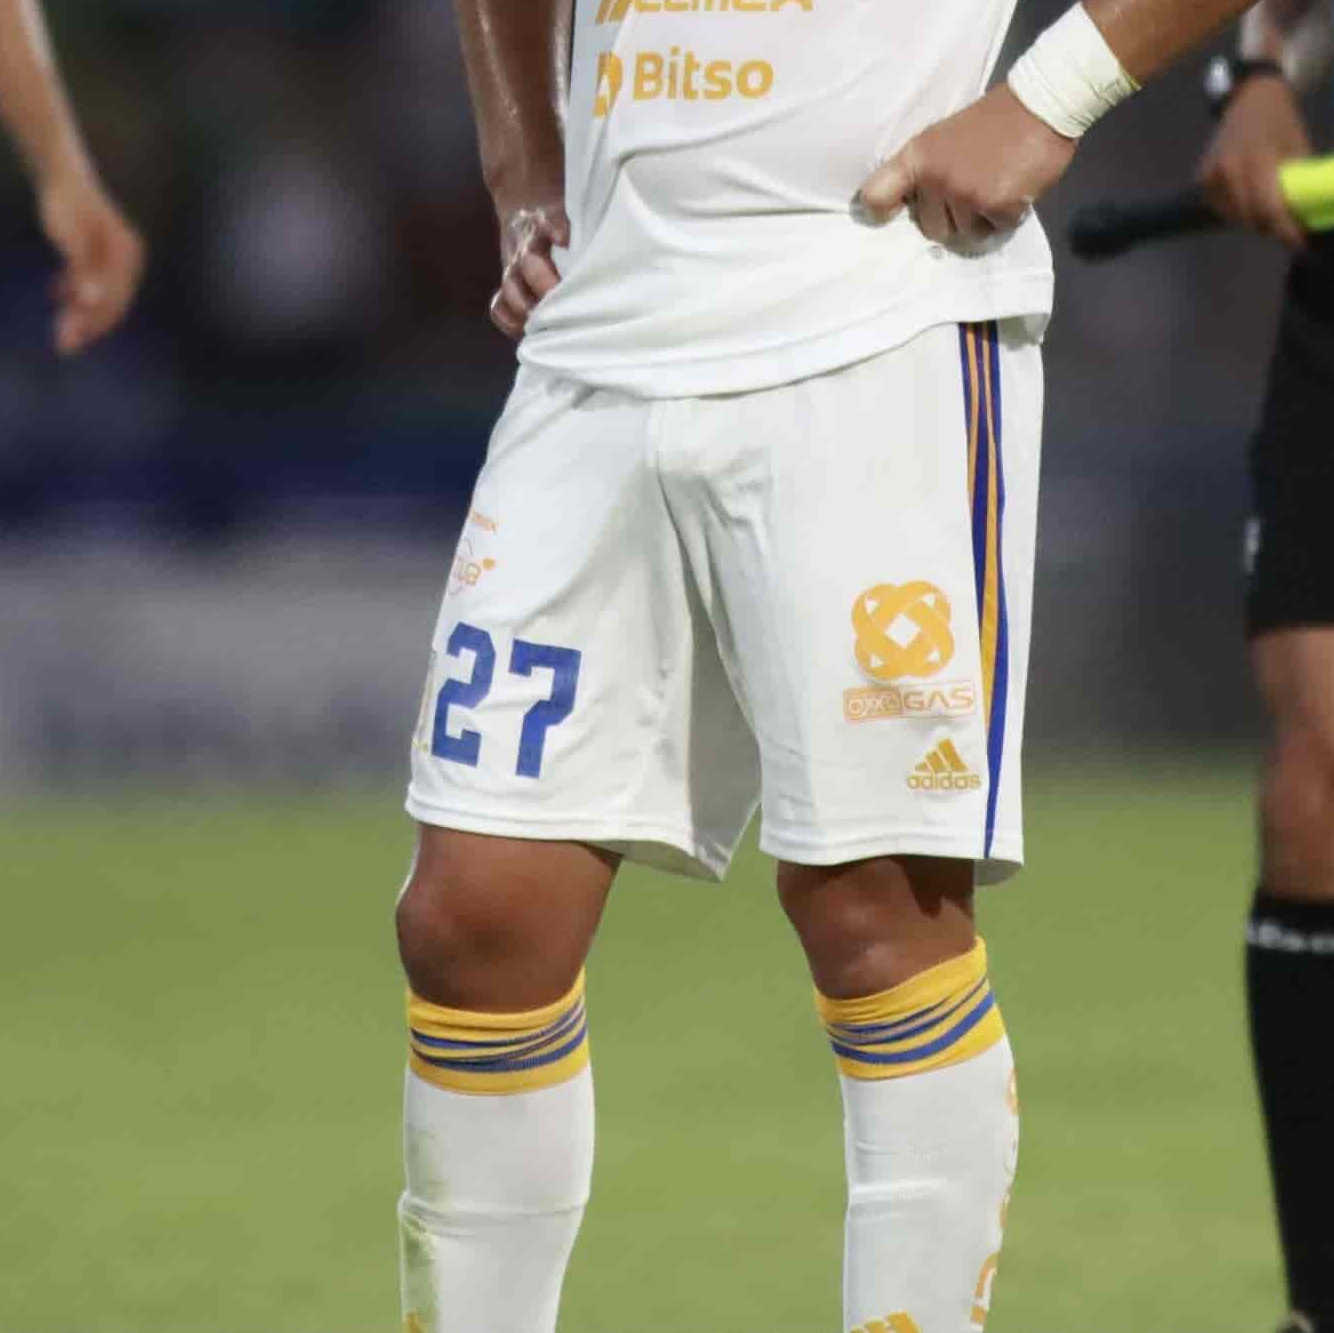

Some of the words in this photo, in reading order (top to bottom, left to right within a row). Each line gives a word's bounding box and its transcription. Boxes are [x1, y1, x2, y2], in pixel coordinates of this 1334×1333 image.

[633, 46, 775, 101] Bitso
[431, 621, 582, 780] 27
[906, 687, 975, 712] GAS
[906, 770, 982, 790] adidas
